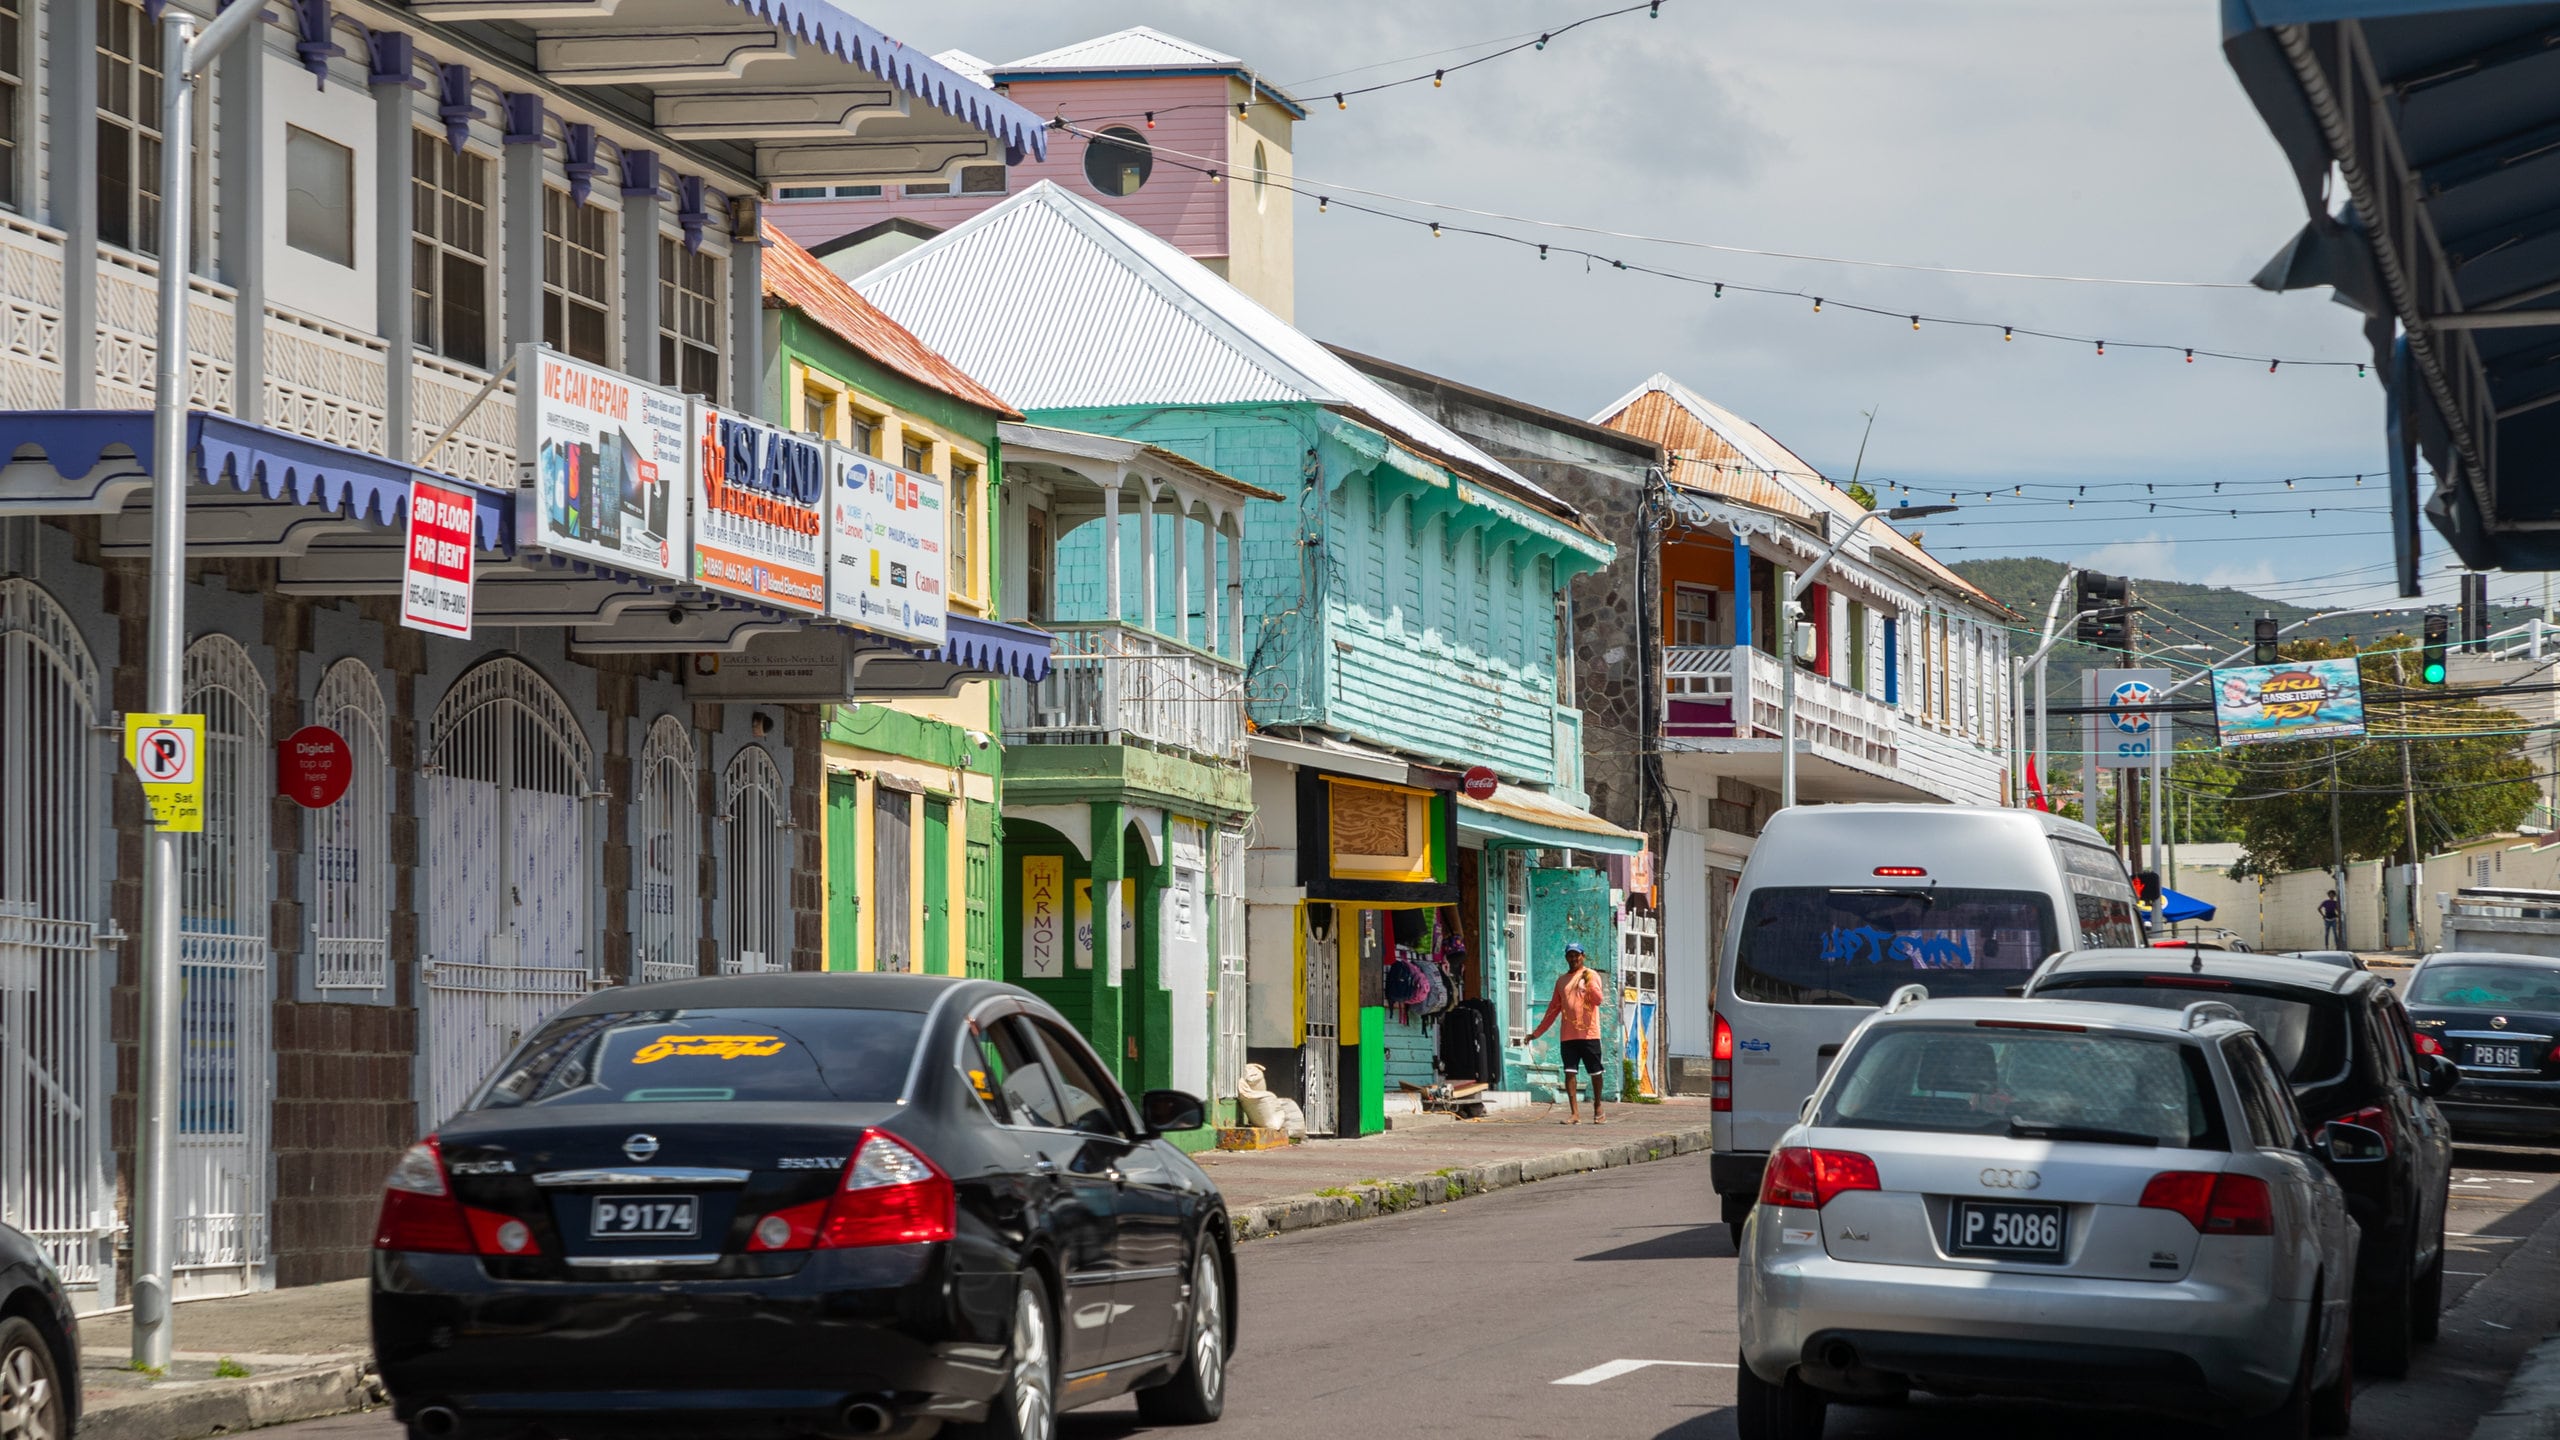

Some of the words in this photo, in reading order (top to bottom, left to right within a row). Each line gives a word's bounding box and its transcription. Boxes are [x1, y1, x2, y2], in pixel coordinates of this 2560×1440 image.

[544, 361, 561, 400] WE
[564, 368, 588, 408] CAN
[589, 377, 629, 422] REPAIR
[720, 418, 823, 503] ISLAND
[414, 496, 436, 524] 3RD
[436, 502, 471, 534] FLOOR
[414, 535, 436, 563] FOR
[437, 541, 467, 570] RENT
[768, 573, 784, 594] Island
[784, 576, 811, 599] Electronics
[915, 570, 940, 595] Canon
[723, 655, 750, 664] CAGE
[2262, 689, 2327, 704] BASSETERRE
[2263, 701, 2323, 720] FEST
[296, 742, 335, 756] Digicel
[2118, 737, 2151, 758] sol
[300, 760, 317, 770] top
[318, 760, 332, 770] up
[304, 772, 327, 781] here
[1466, 777, 1494, 788] Coca-Cola
[174, 793, 193, 803] Sat
[170, 806, 176, 816] 7
[179, 808, 197, 818] pm
[1032, 873, 1053, 973] HARMONY
[1820, 925, 1973, 966] UPTOWN
[2475, 1047, 2494, 1063] PB
[2496, 1048, 2519, 1065] 615
[599, 1204, 618, 1232] P
[624, 1203, 694, 1231] 9174
[1965, 1211, 1985, 1243] P
[1992, 1212, 2058, 1247] 5086
